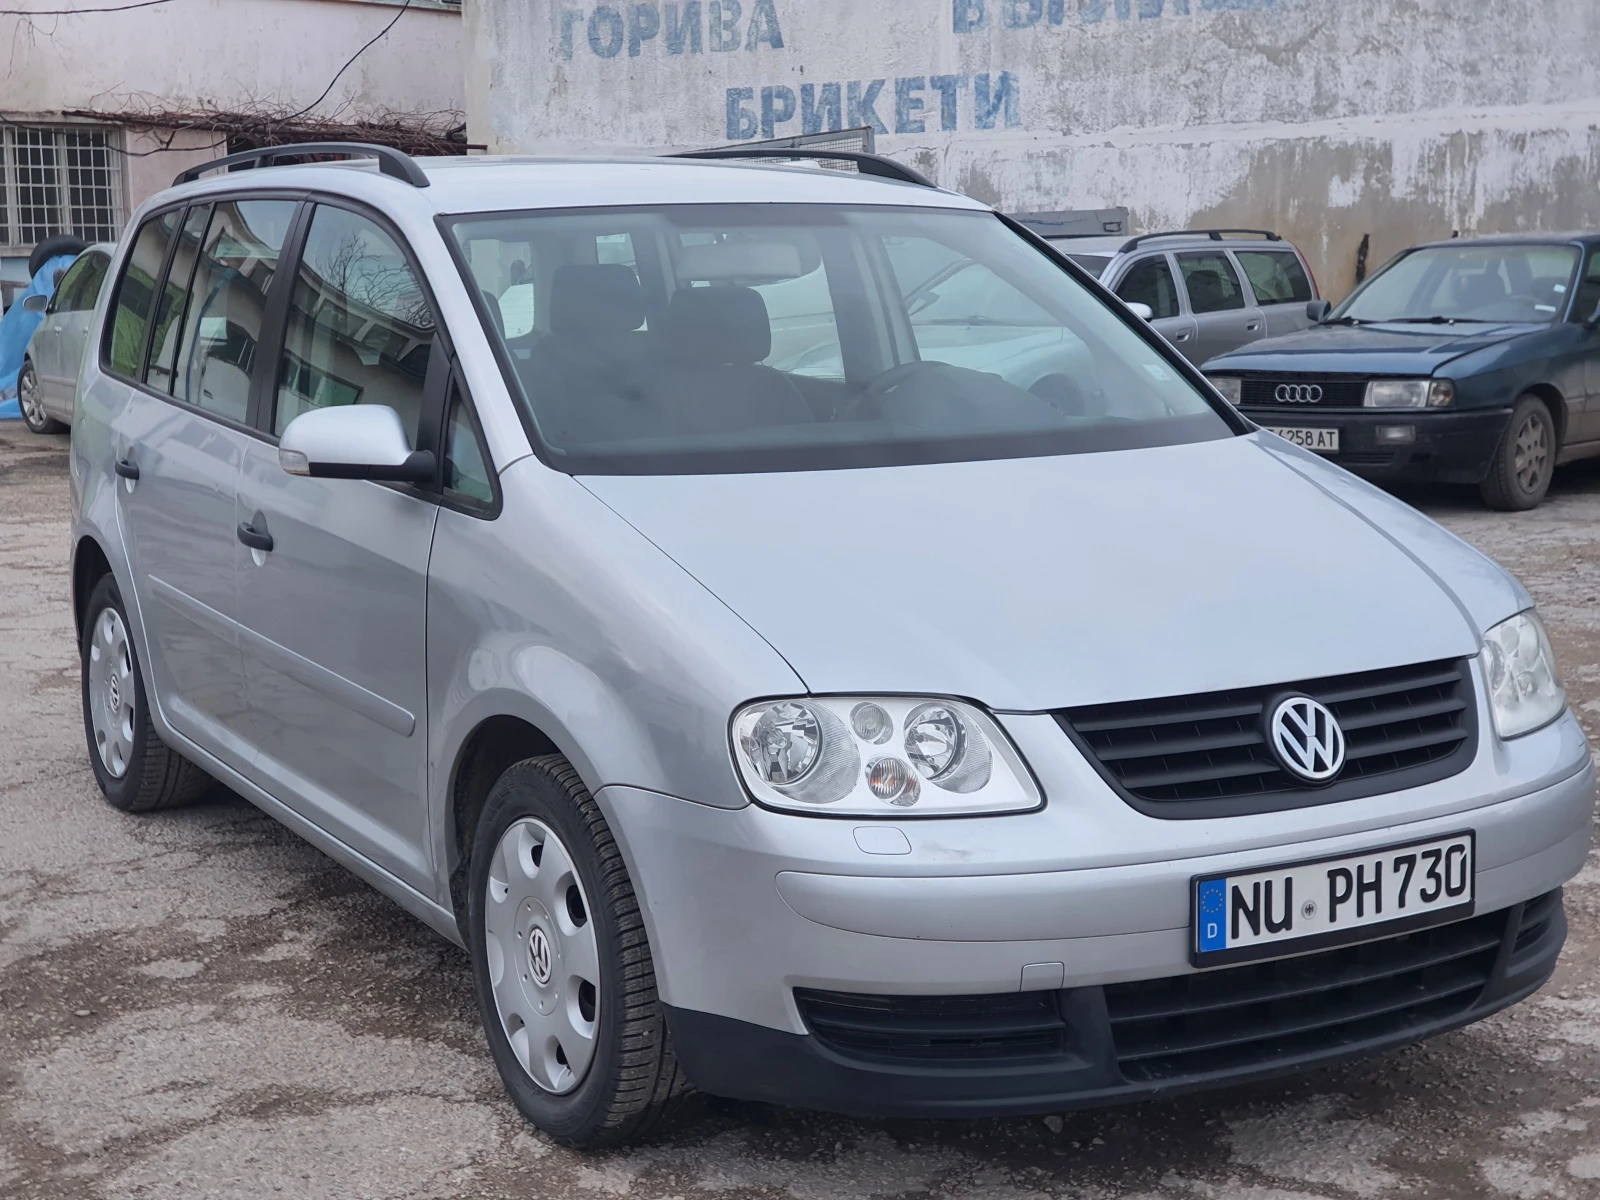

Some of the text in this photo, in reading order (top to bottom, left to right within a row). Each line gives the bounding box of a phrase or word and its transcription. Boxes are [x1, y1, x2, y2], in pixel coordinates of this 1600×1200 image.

[559, 0, 785, 60] ГОРИВА
[726, 70, 1020, 140] БРИКЕТИ
[1317, 430, 1336, 448] AT
[1272, 697, 1345, 779] VW
[1230, 843, 1467, 940] NU PH 730
[1206, 922, 1218, 939] D
